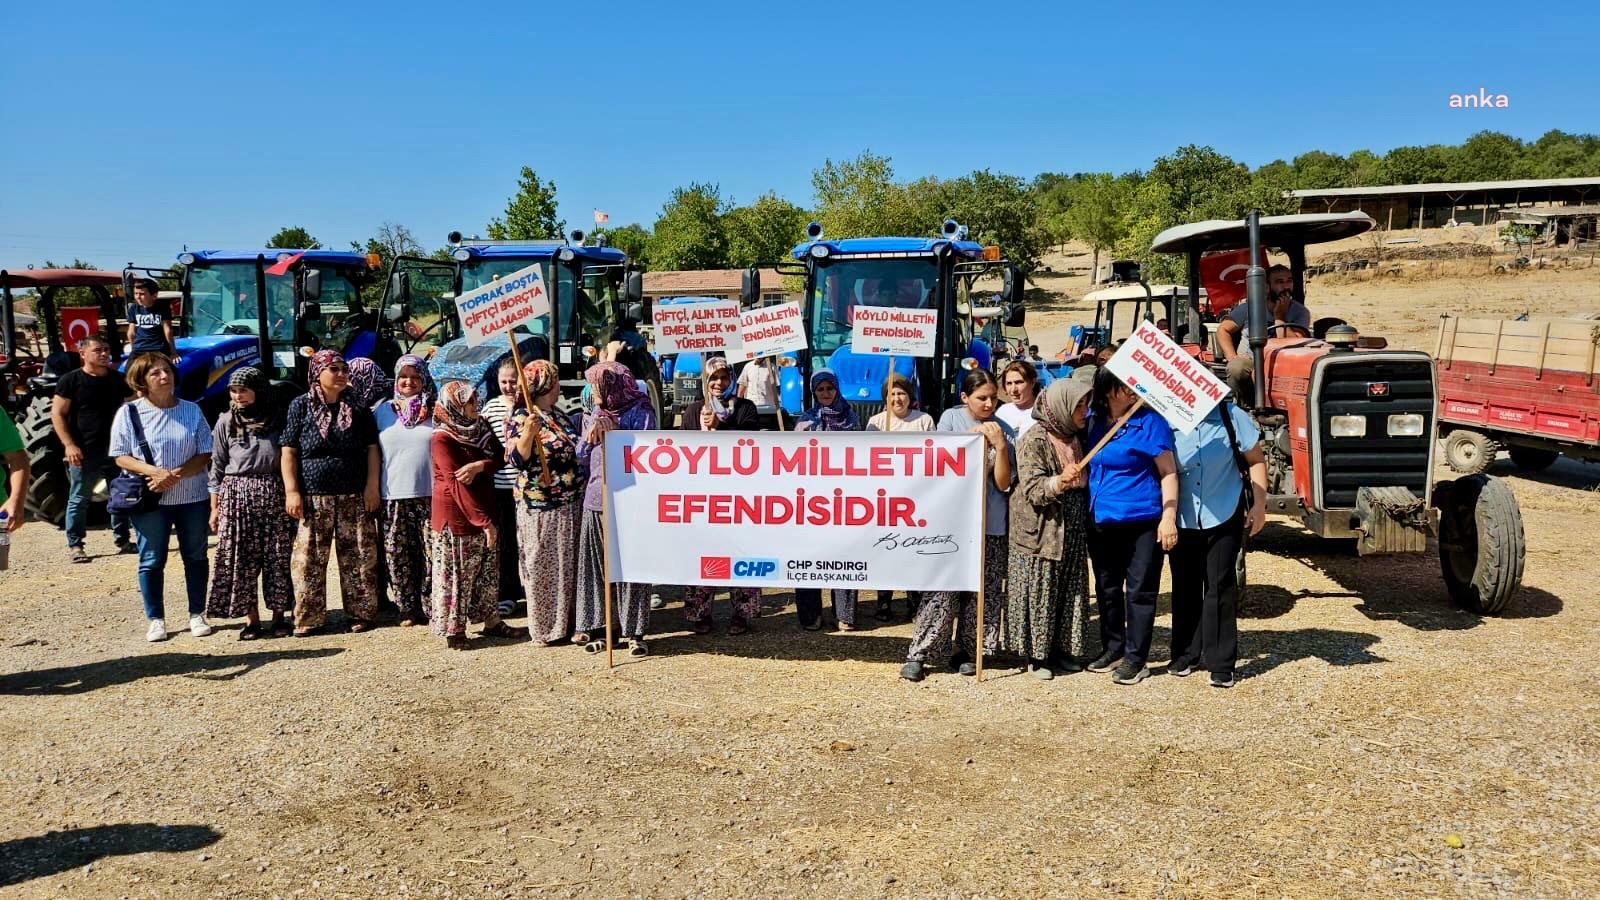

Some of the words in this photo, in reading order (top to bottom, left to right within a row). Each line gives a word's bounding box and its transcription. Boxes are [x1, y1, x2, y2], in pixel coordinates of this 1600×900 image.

[460, 286, 504, 312] TOPRAK
[504, 272, 539, 293] BOŞTA
[465, 303, 499, 329] ÇİFTÇİ
[500, 287, 542, 311] BORÇTA
[654, 308, 689, 324] ÇİFTÇİ,
[691, 309, 714, 320] ALIN
[754, 307, 799, 325] MİLLETİN
[855, 310, 888, 322] KÖYLÜ
[890, 311, 935, 324] MİLLETİN
[481, 305, 534, 336] KALMASIN
[663, 325, 693, 336] EMEK,
[695, 322, 722, 334] BİLEK
[742, 324, 794, 342] ENDİSİDİR.
[863, 326, 925, 339] EFENDİSİDİR.
[675, 335, 727, 349] YÜREKTİR.
[1136, 326, 1176, 360] KÖYLÜ
[1171, 355, 1223, 401] MİLLETİN
[1131, 348, 1197, 409] EFENDİSİDİR.
[623, 438, 760, 476] KÖYLÜ
[772, 438, 966, 477] MİLLETİN
[657, 487, 927, 528] EFENDİSİDİR.
[734, 560, 776, 577] CHP
[787, 560, 813, 570] CHP
[816, 560, 868, 571] SINDIRGI
[787, 571, 808, 581] İLÇE
[810, 571, 868, 583] BAŞKANLIĞI
